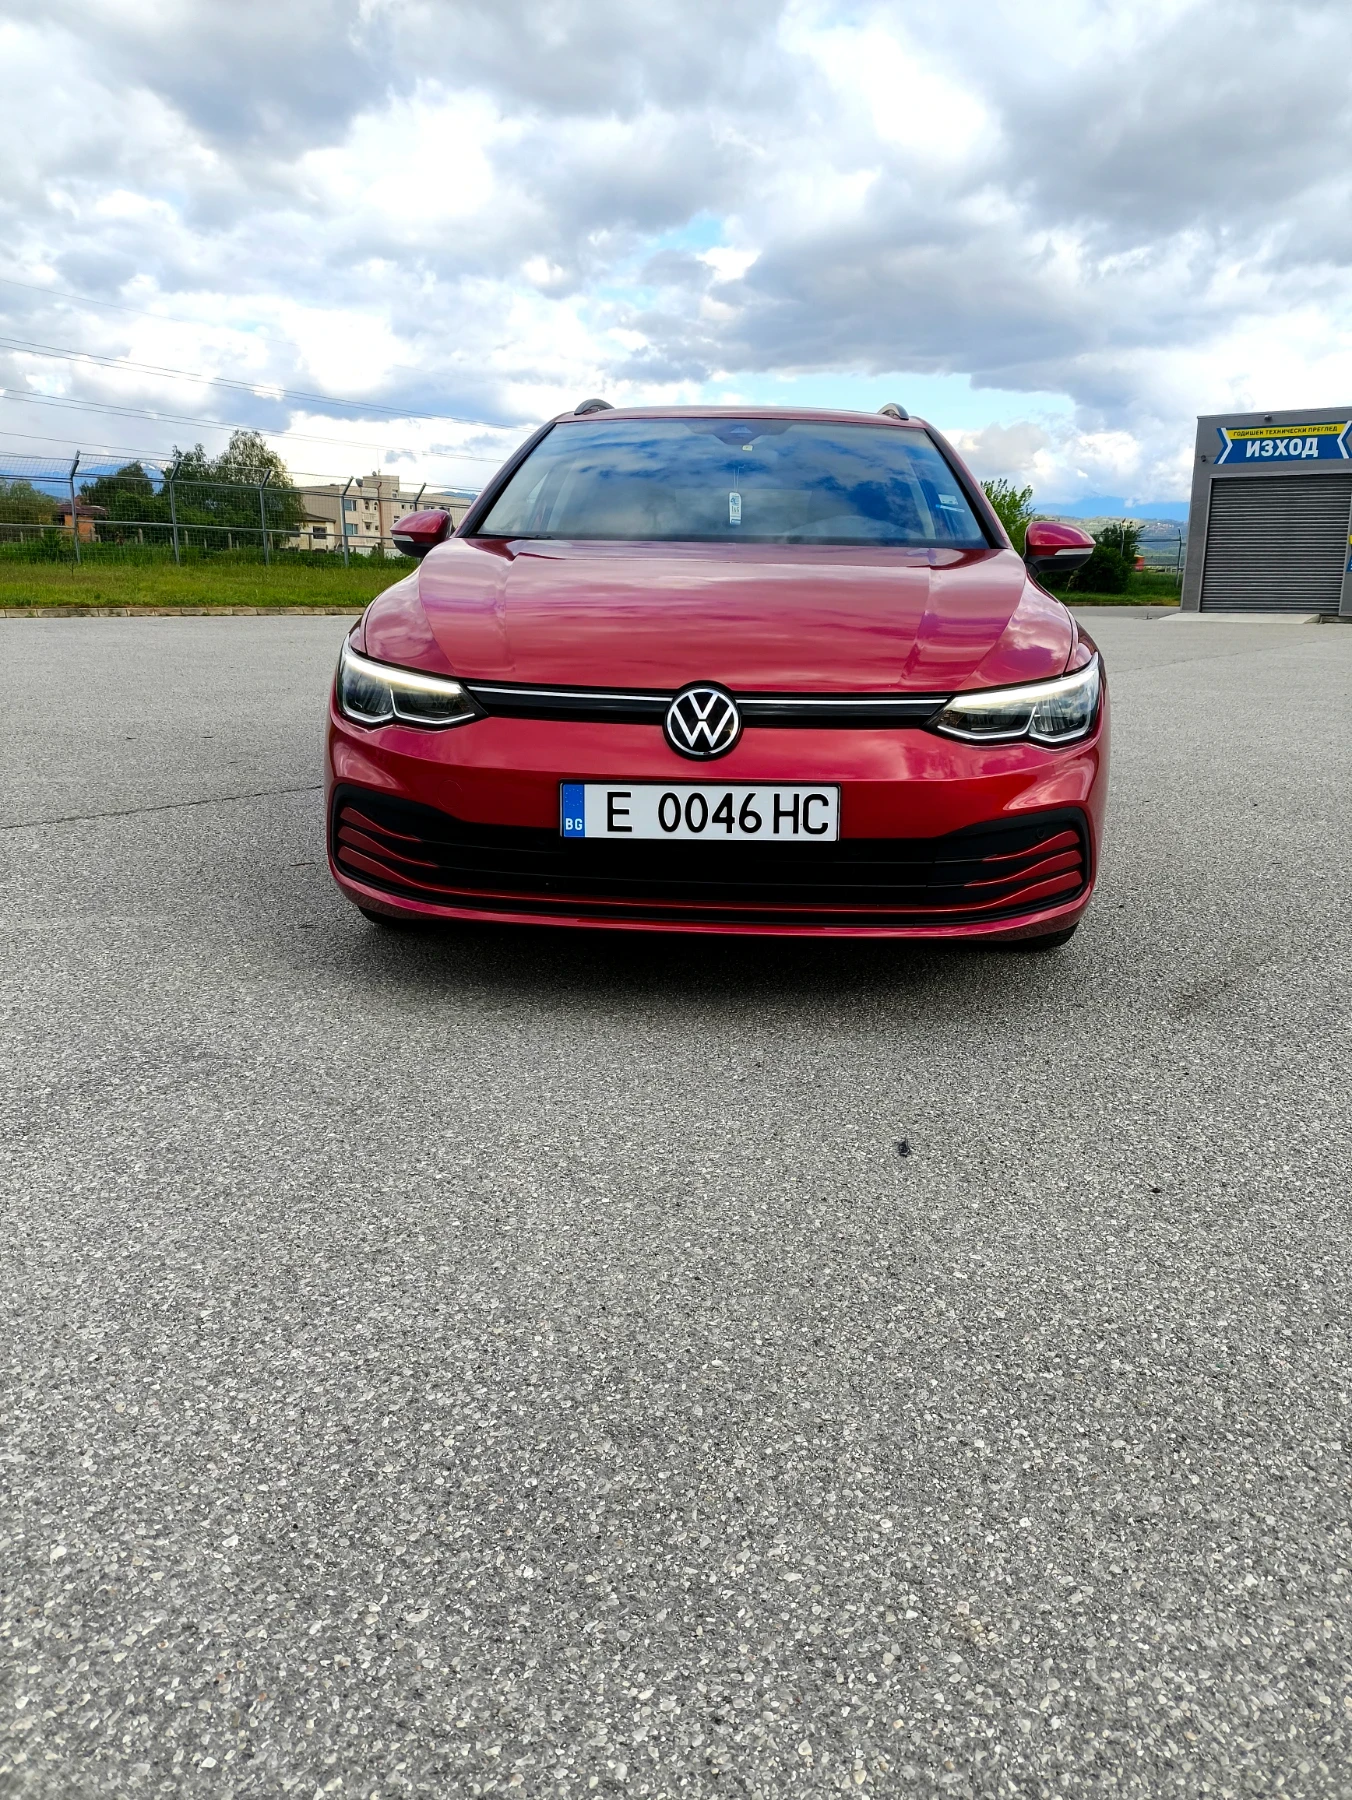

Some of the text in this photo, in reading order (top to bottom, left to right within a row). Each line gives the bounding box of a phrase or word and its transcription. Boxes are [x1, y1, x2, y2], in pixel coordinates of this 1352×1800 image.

[1265, 427, 1307, 435] ТЕХНИЧЕСКИ
[1308, 425, 1338, 433] ПРЕГЛЕД
[1245, 437, 1319, 458] ИЗХОД
[670, 690, 735, 749] VW
[606, 791, 829, 835] E 0046 HC
[565, 818, 583, 831] BG
